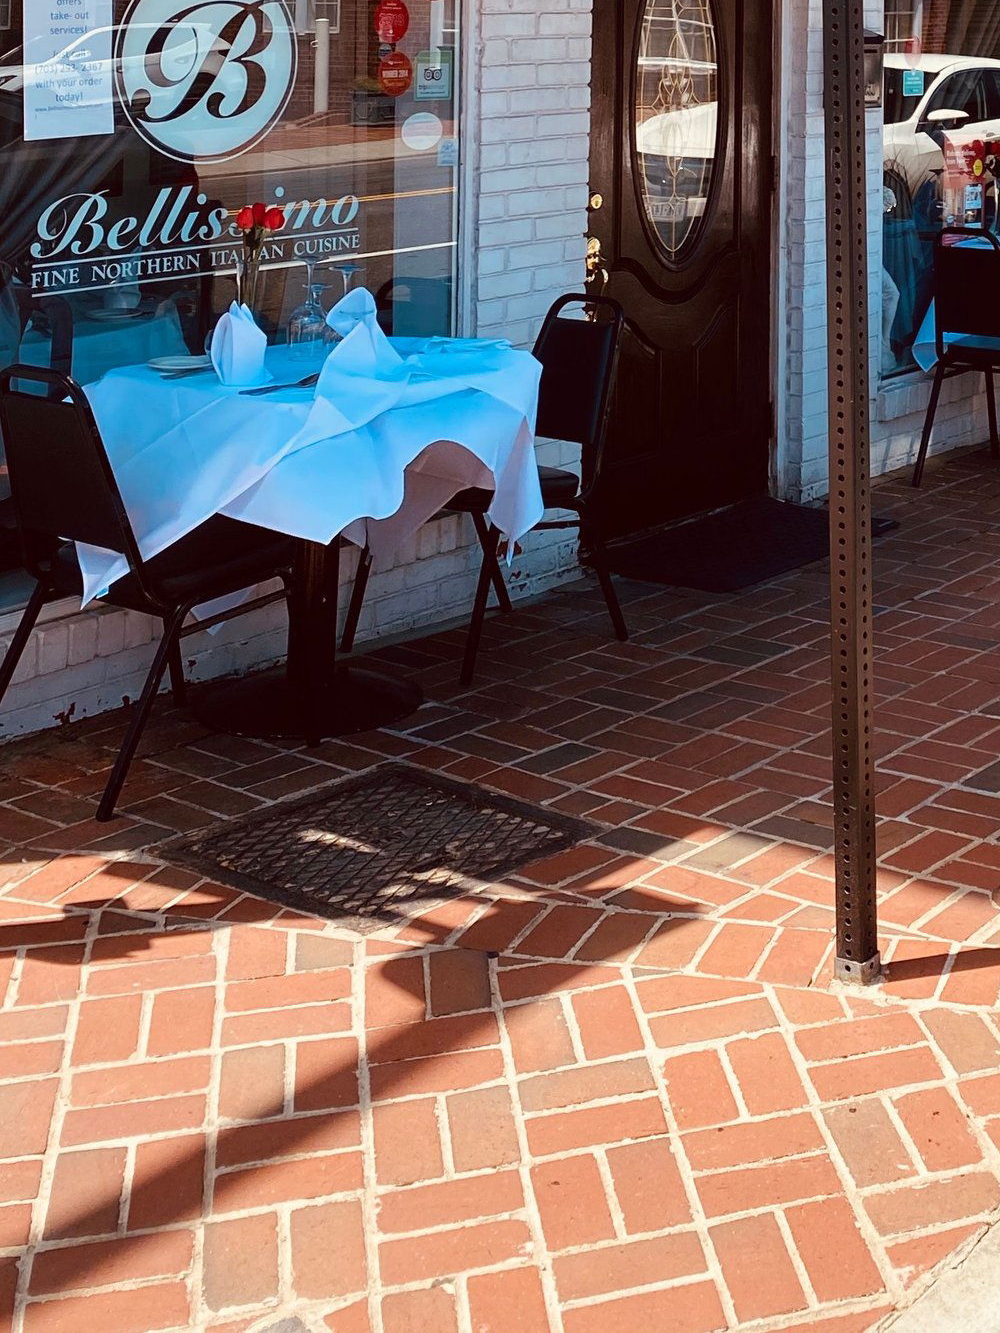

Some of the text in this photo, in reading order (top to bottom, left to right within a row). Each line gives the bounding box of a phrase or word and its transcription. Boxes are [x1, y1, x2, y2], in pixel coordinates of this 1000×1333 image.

[74, 11, 89, 20] out
[50, 25, 88, 35] services!
[51, 48, 70, 59] Jst
[35, 76, 103, 89] with your order
[55, 91, 84, 102] today!
[31, 267, 80, 289] FINE
[92, 253, 201, 282] NORTHERN
[294, 234, 360, 256] CUISINE
